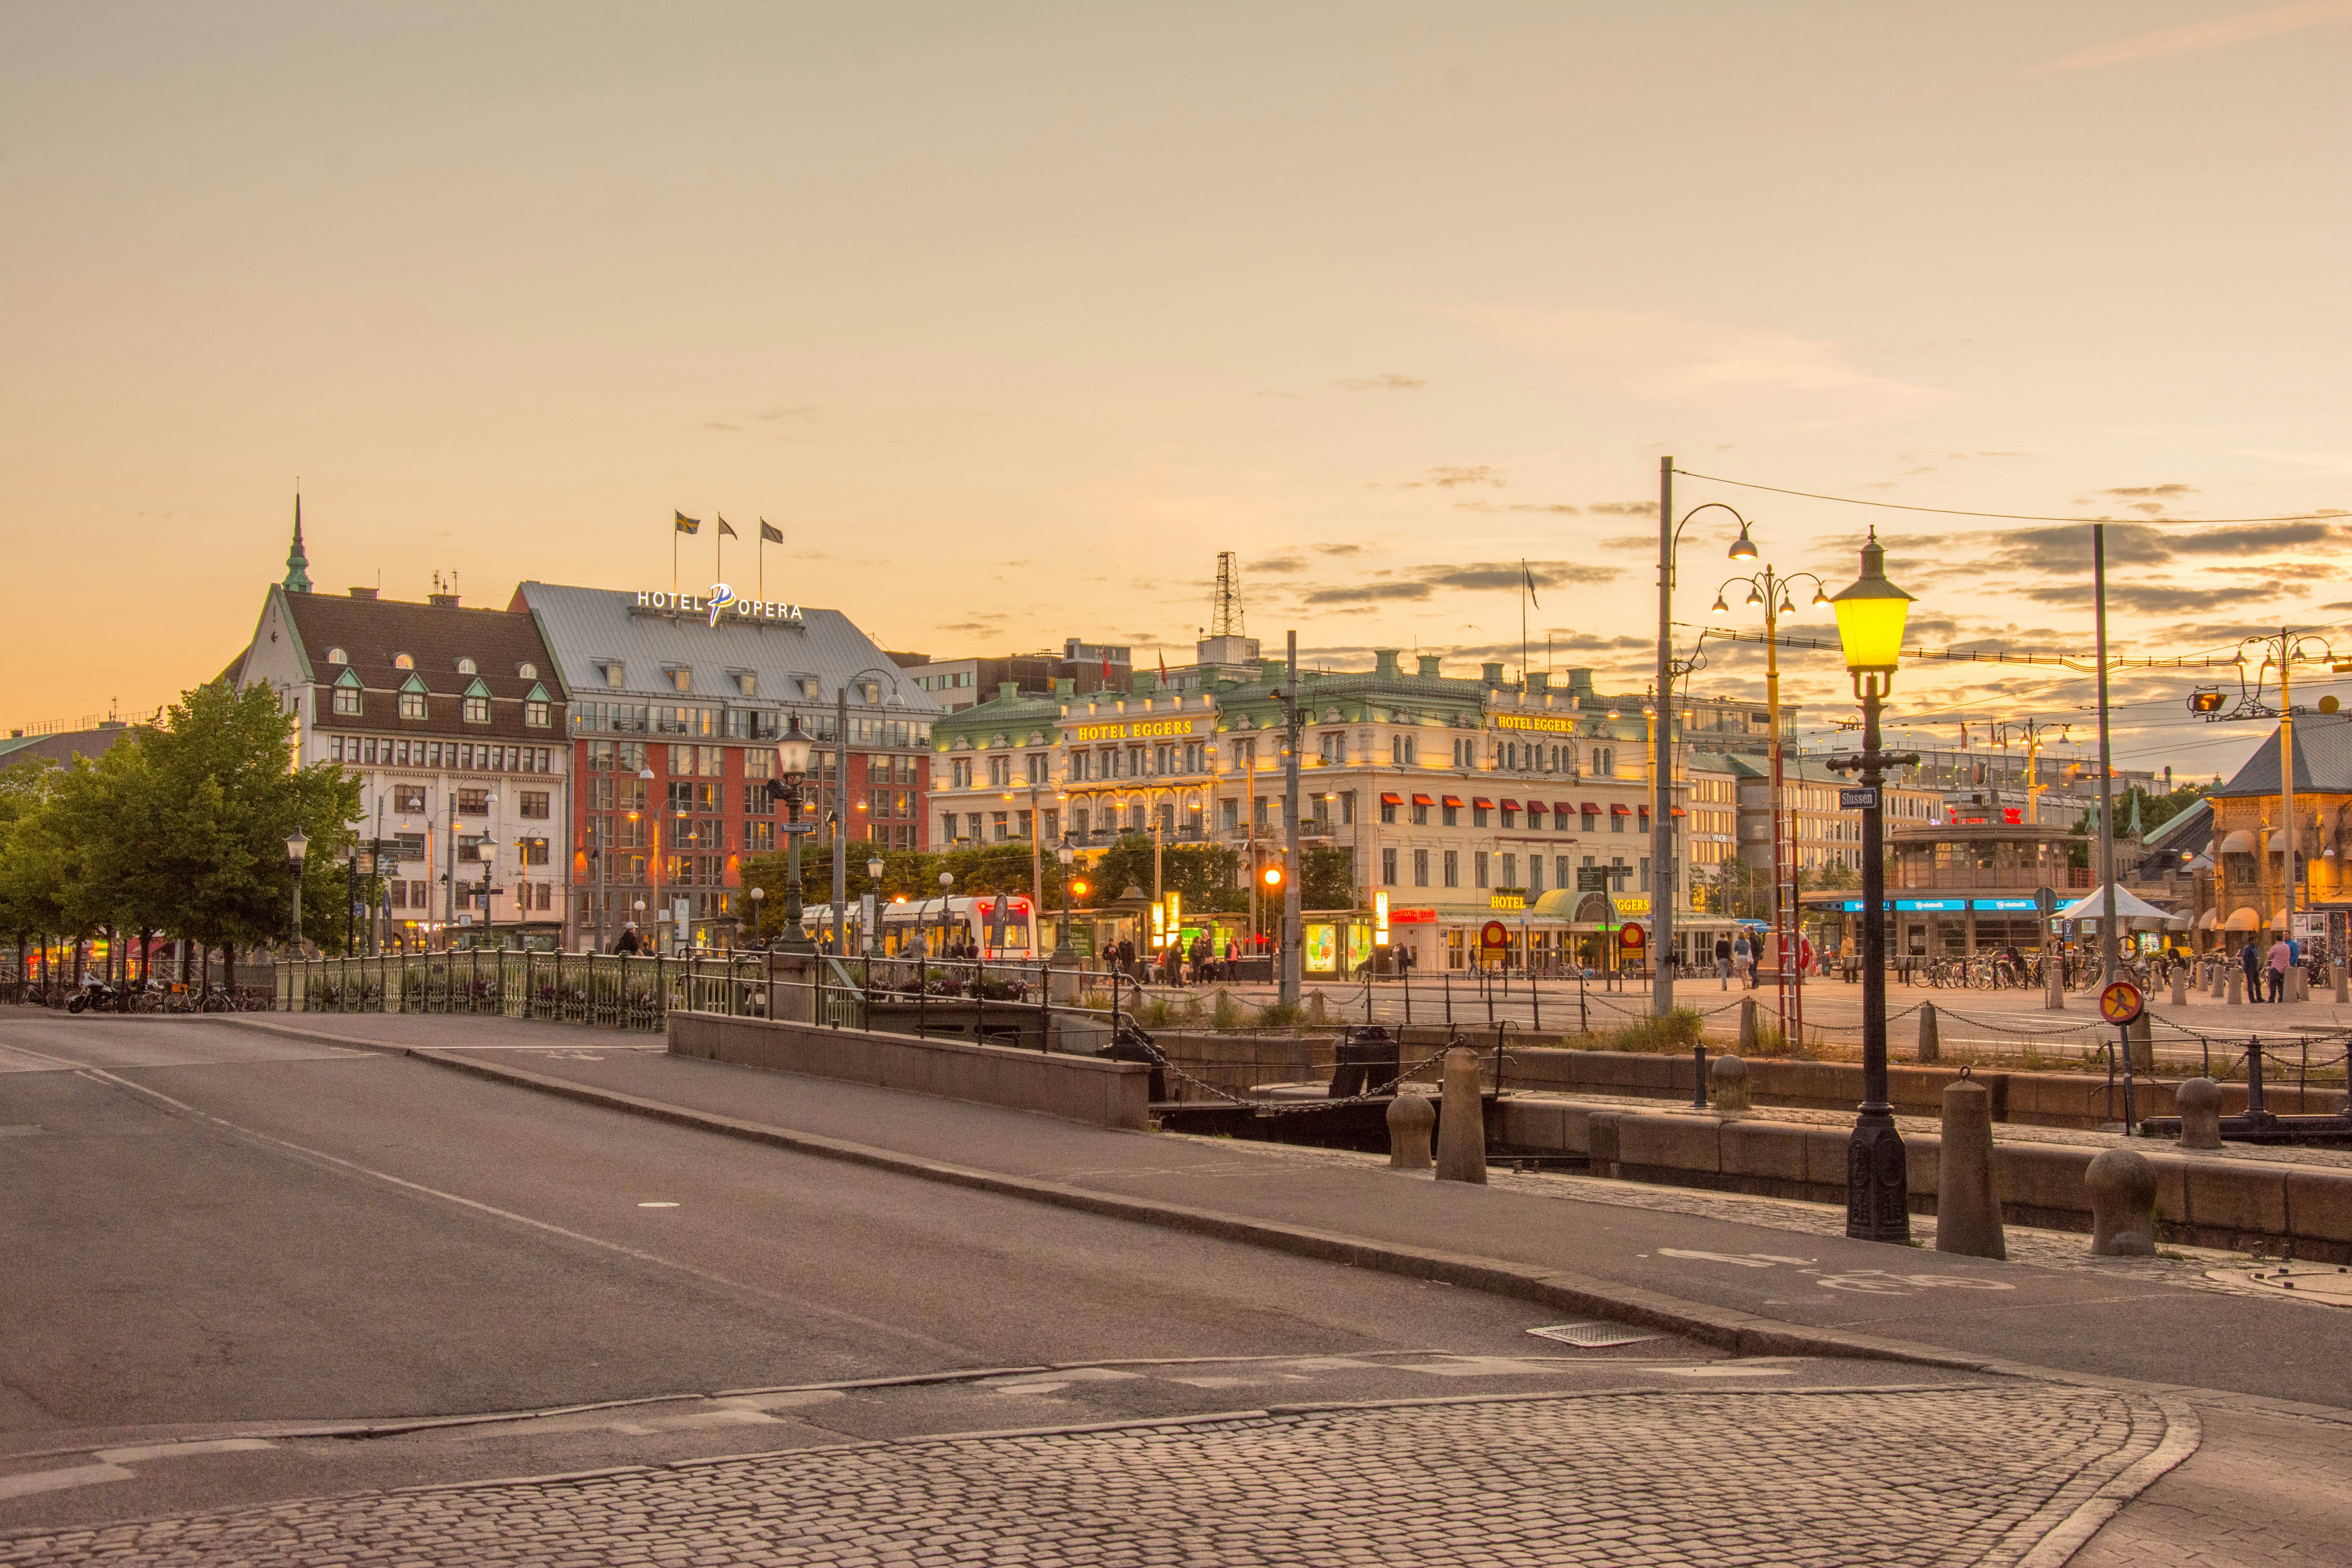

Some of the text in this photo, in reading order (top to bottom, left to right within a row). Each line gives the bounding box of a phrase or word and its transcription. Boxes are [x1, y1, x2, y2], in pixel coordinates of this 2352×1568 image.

[637, 590, 703, 611] HOTEL
[738, 599, 803, 620] OPERA
[1079, 720, 1192, 741] HOTEL EGGERS
[1498, 716, 1573, 732] HOTEL EGGERS
[1842, 792, 1873, 805] Slussen
[679, 901, 685, 911] A
[1171, 895, 1176, 905] C
[1491, 896, 1527, 909] HOTEL
[2066, 922, 2071, 934] P
